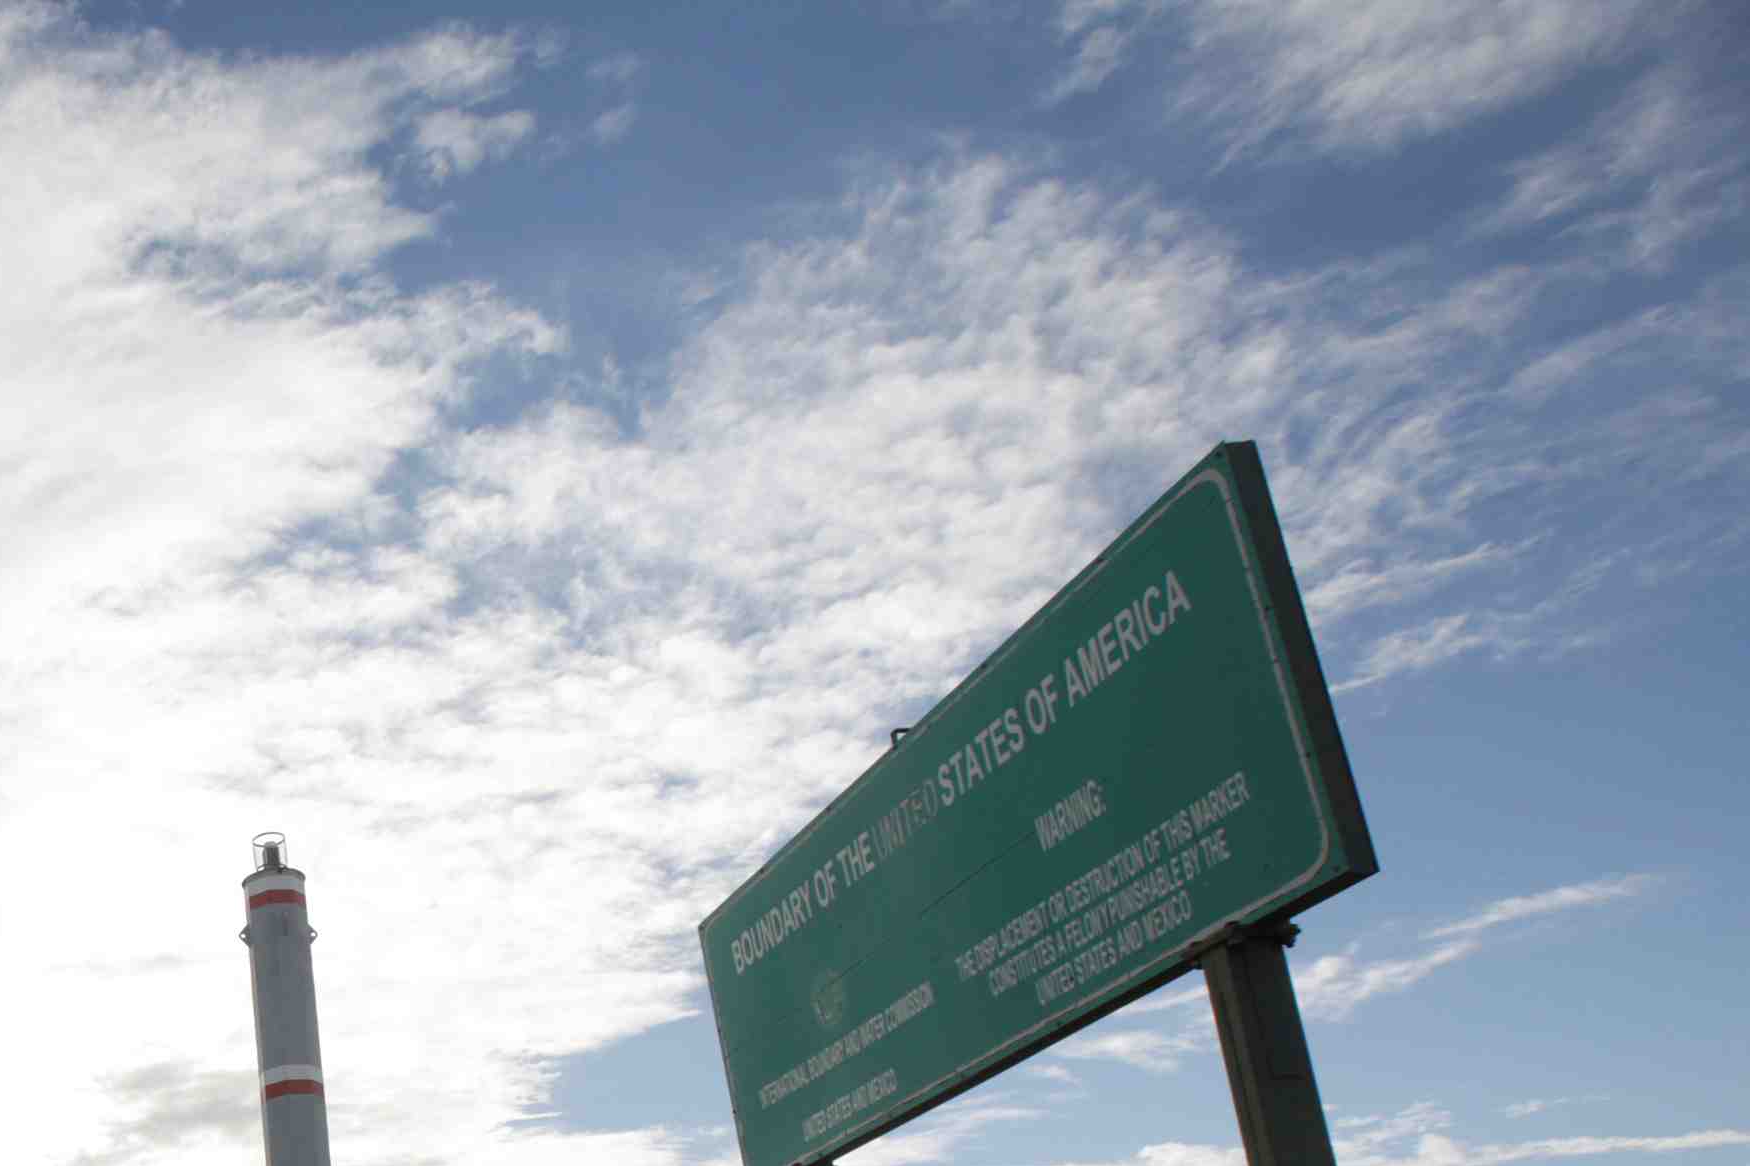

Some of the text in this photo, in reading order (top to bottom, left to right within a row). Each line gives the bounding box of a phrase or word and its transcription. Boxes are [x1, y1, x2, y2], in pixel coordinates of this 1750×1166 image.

[731, 880, 814, 974] BOUNDARY
[814, 861, 838, 908] OF
[836, 832, 875, 887] THE
[937, 708, 1025, 806] STATES
[1024, 674, 1057, 735] OF
[1063, 570, 1192, 707] AMERICA
[1066, 841, 1146, 913] DESTRUCTION
[1143, 829, 1161, 863] OF
[1160, 808, 1193, 854] THIS
[1189, 771, 1250, 835] MARKER
[1181, 842, 1202, 881] BY
[1199, 827, 1232, 868] THE
[1073, 937, 1117, 987] STATES
[1117, 919, 1146, 957] AND
[1142, 889, 1193, 943] MEXICO
